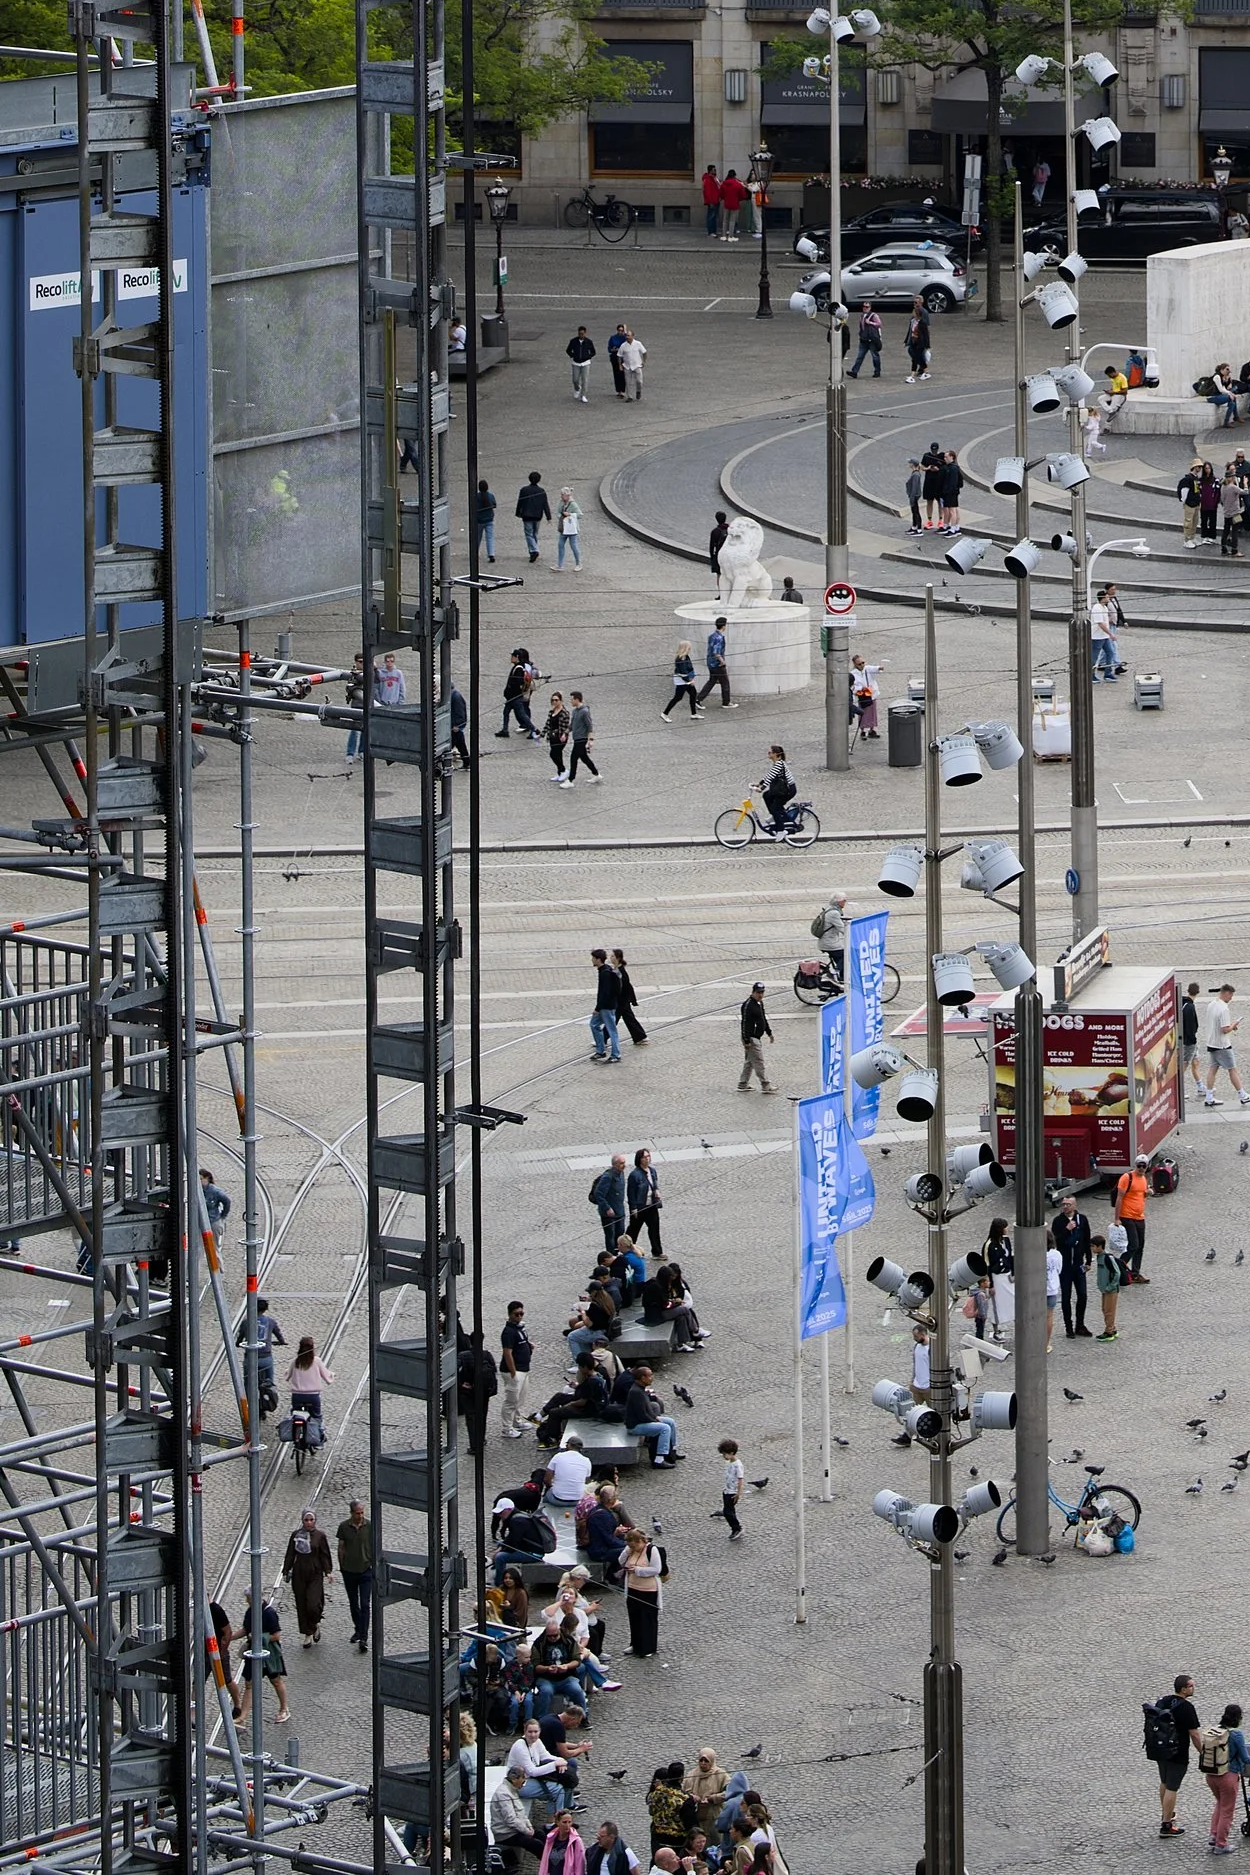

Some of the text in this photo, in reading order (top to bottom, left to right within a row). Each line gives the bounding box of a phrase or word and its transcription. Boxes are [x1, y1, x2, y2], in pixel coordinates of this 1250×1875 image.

[782, 90, 846, 98] KRASNAPOLY
[859, 940, 876, 1045] UNITED
[811, 1121, 829, 1238] UNITED
[822, 1108, 838, 1210] WAVES
[815, 1309, 837, 1323] 2025
